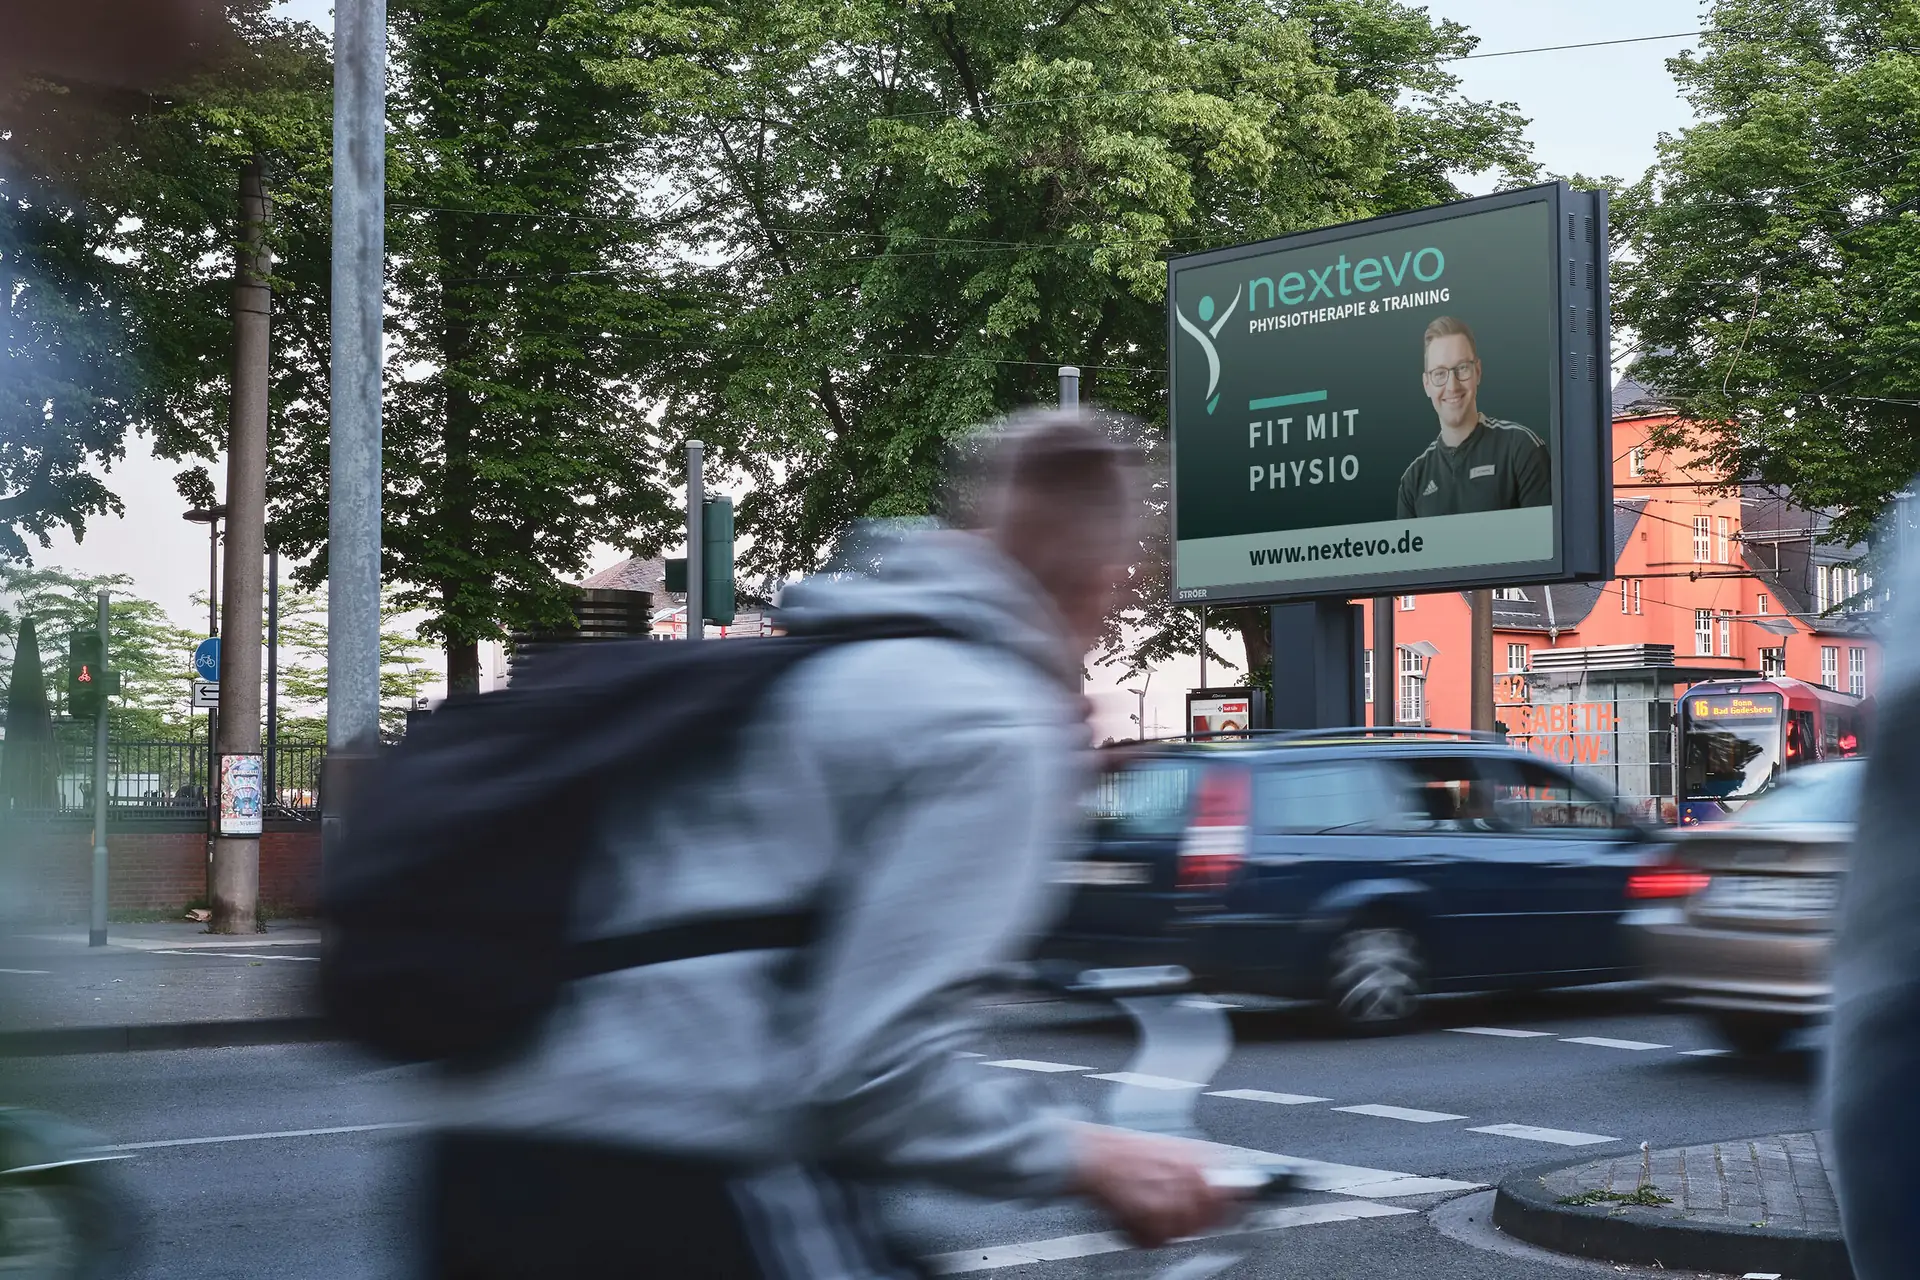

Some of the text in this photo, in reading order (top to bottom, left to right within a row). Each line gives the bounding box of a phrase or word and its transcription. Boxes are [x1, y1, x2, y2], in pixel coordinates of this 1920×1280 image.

[1249, 247, 1445, 311] nextevo
[1249, 288, 1450, 333] PHYISIOTHERAPIE & TRAINING
[1249, 408, 1359, 448] FIT MIT
[1249, 454, 1359, 491] PHYSIO
[1249, 529, 1424, 566] www.nextevo.de
[1694, 700, 1709, 716] 16
[1713, 706, 1773, 715] Bad Godesberg
[1732, 699, 1753, 707] Bonn
